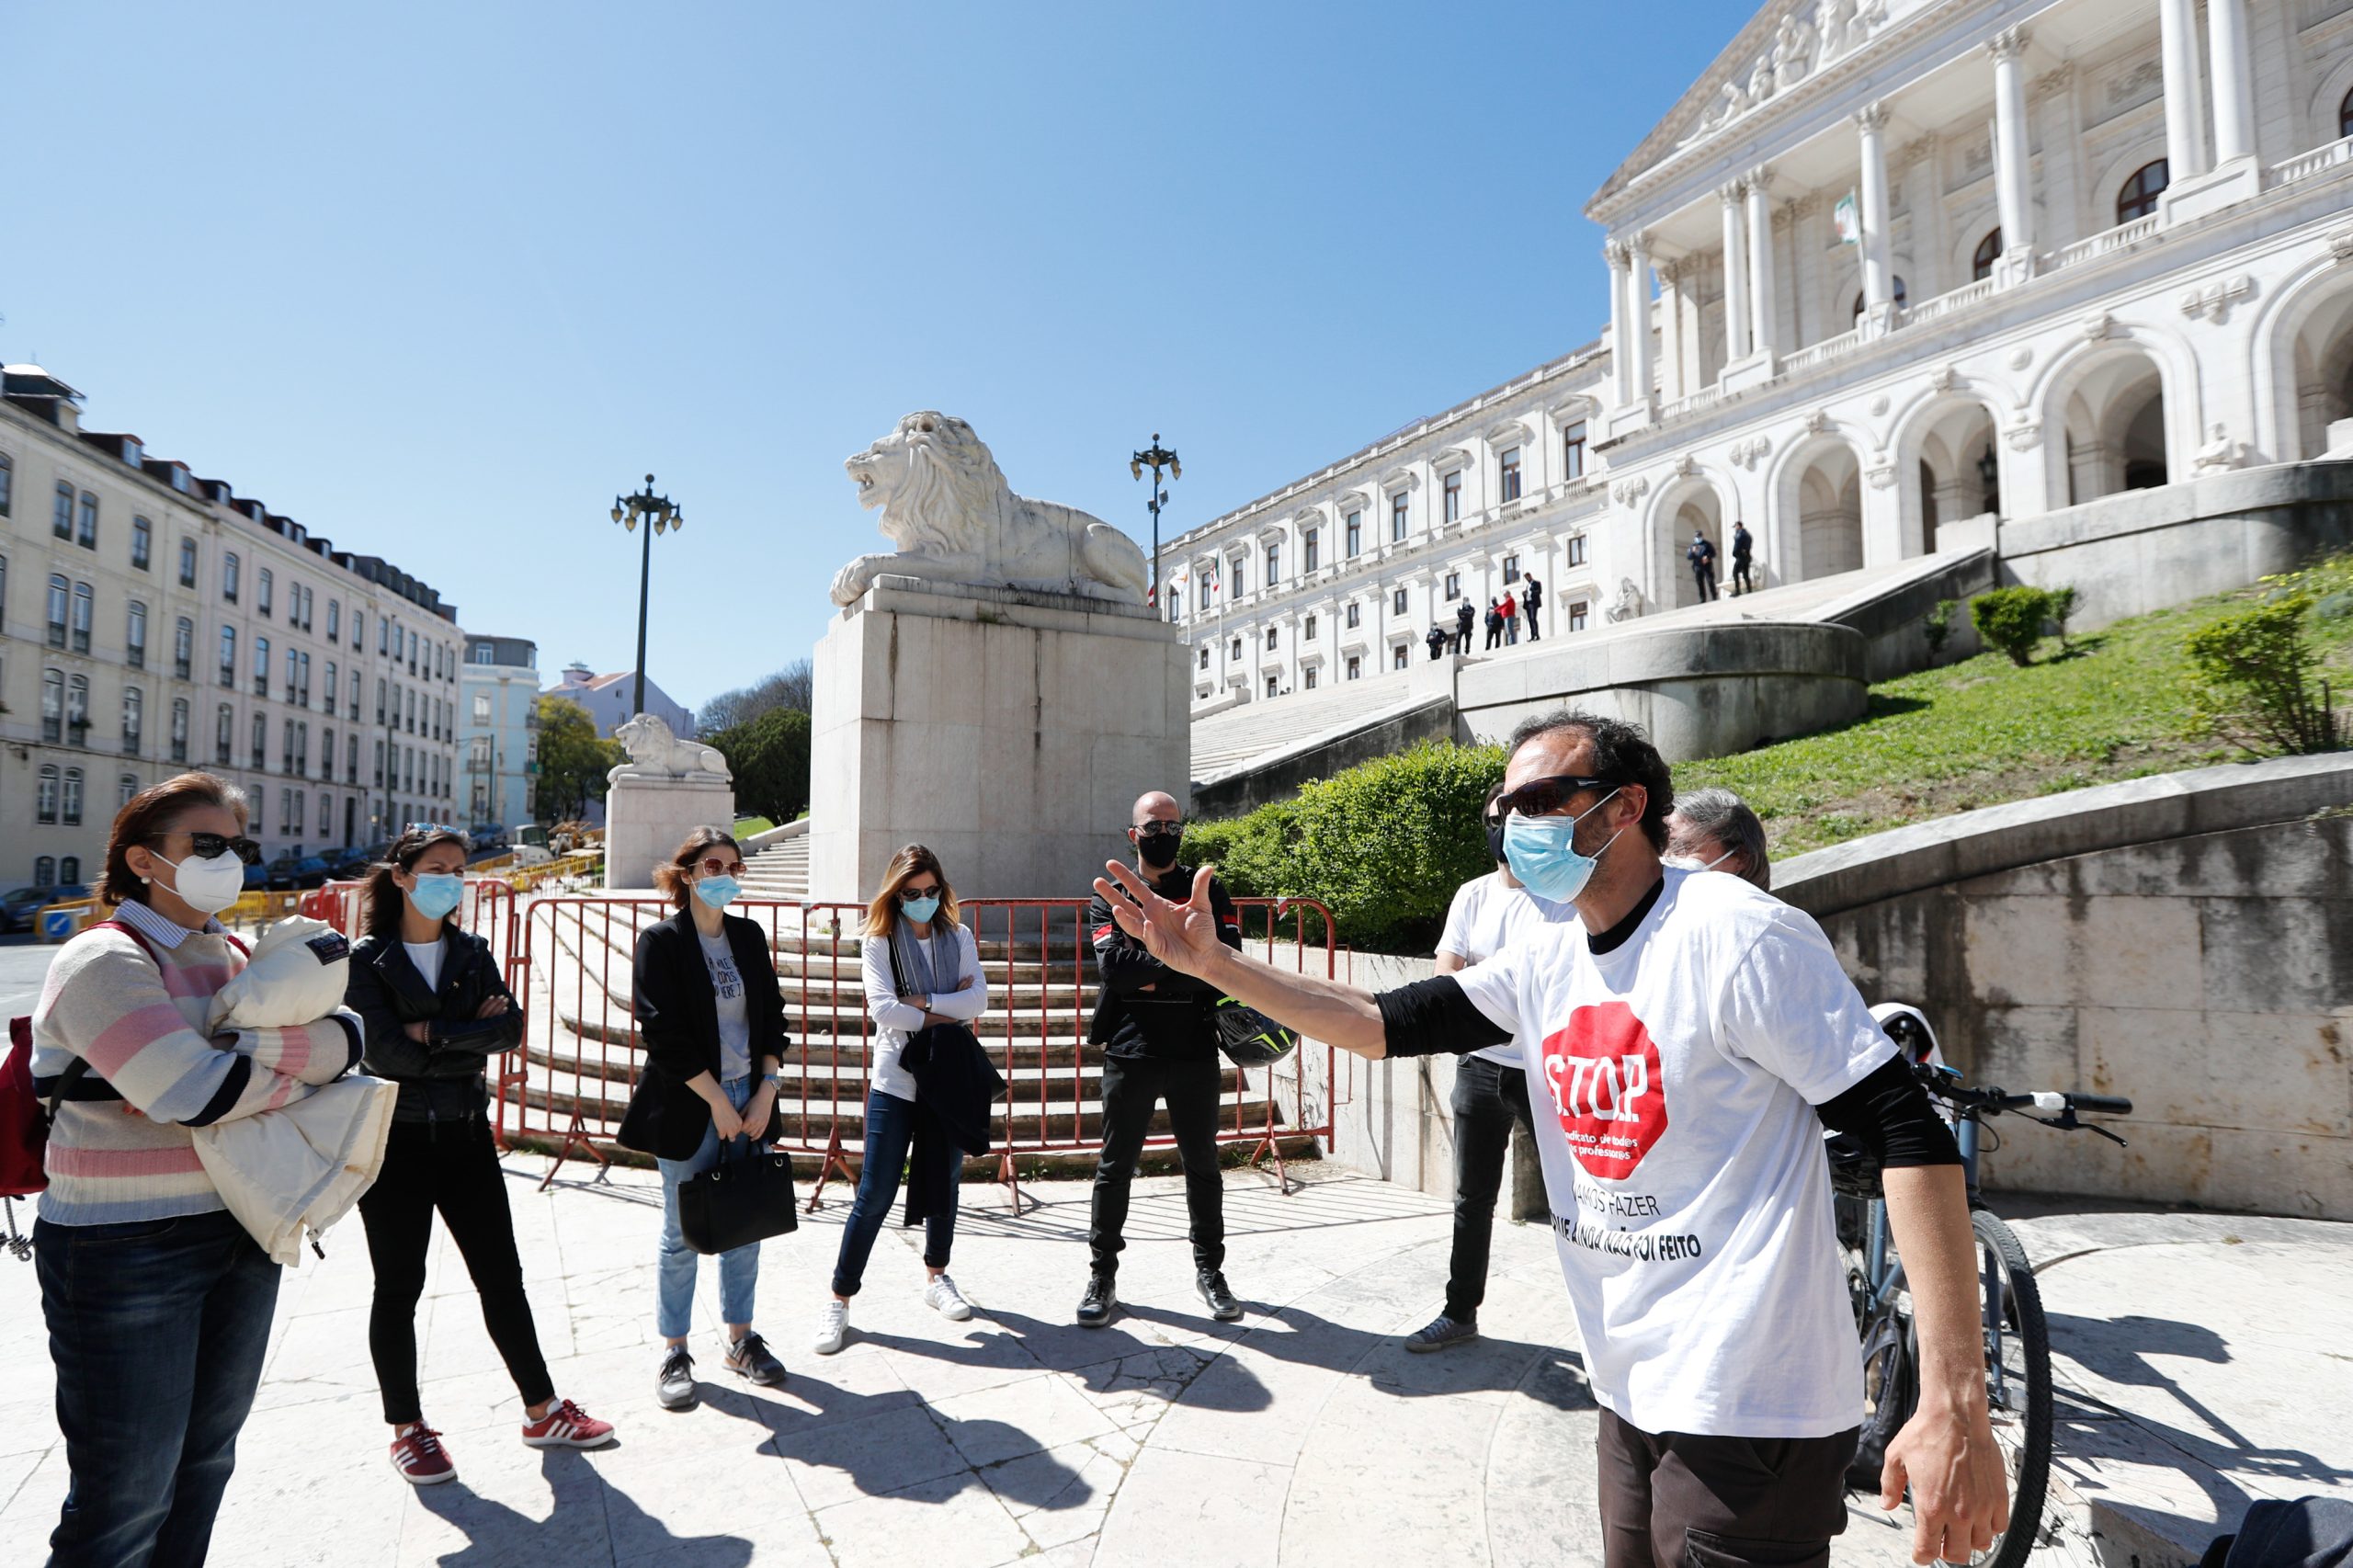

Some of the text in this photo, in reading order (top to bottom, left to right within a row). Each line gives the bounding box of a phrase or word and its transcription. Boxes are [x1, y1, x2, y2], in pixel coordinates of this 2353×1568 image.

[1608, 1194, 1661, 1218] FAZER
[1572, 1221, 1604, 1252] AINDA
[1634, 1234, 1656, 1262] FOI
[1659, 1233, 1701, 1262] FEITO
